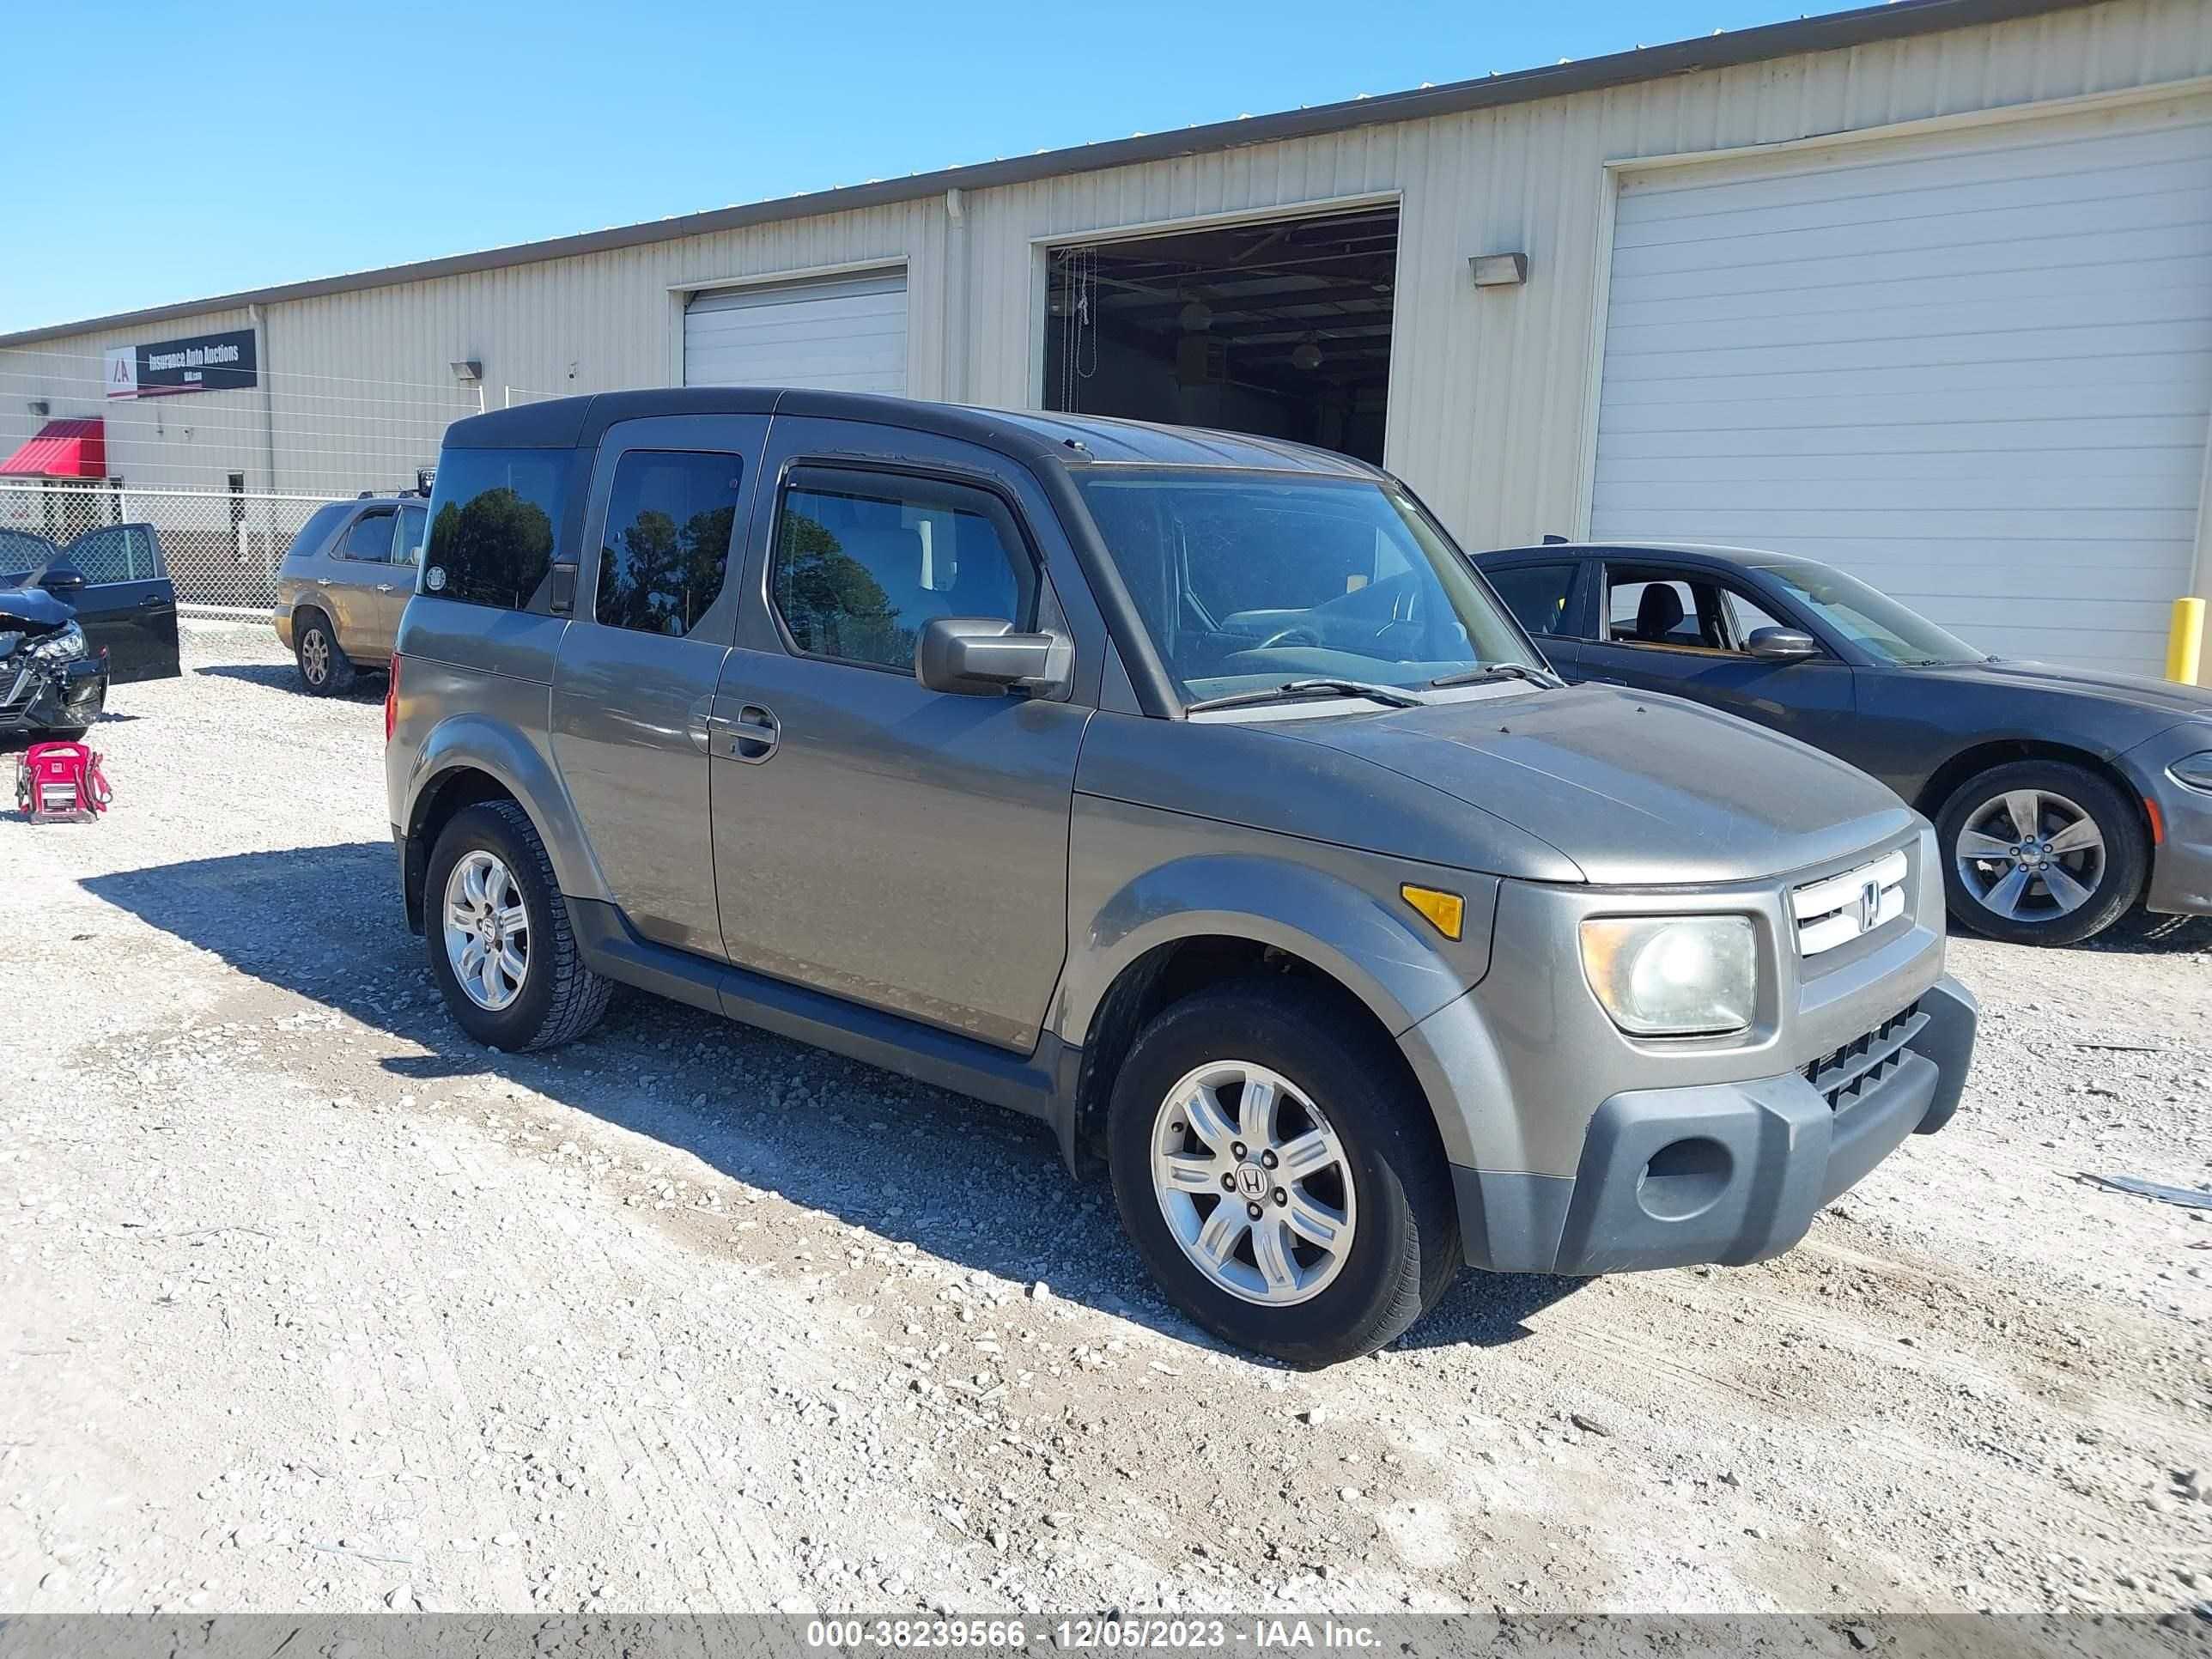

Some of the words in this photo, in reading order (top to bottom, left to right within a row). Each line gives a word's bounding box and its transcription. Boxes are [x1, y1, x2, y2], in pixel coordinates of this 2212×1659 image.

[149, 353, 185, 372] Insurance
[185, 348, 204, 366] Auto
[204, 343, 239, 365] Auctions
